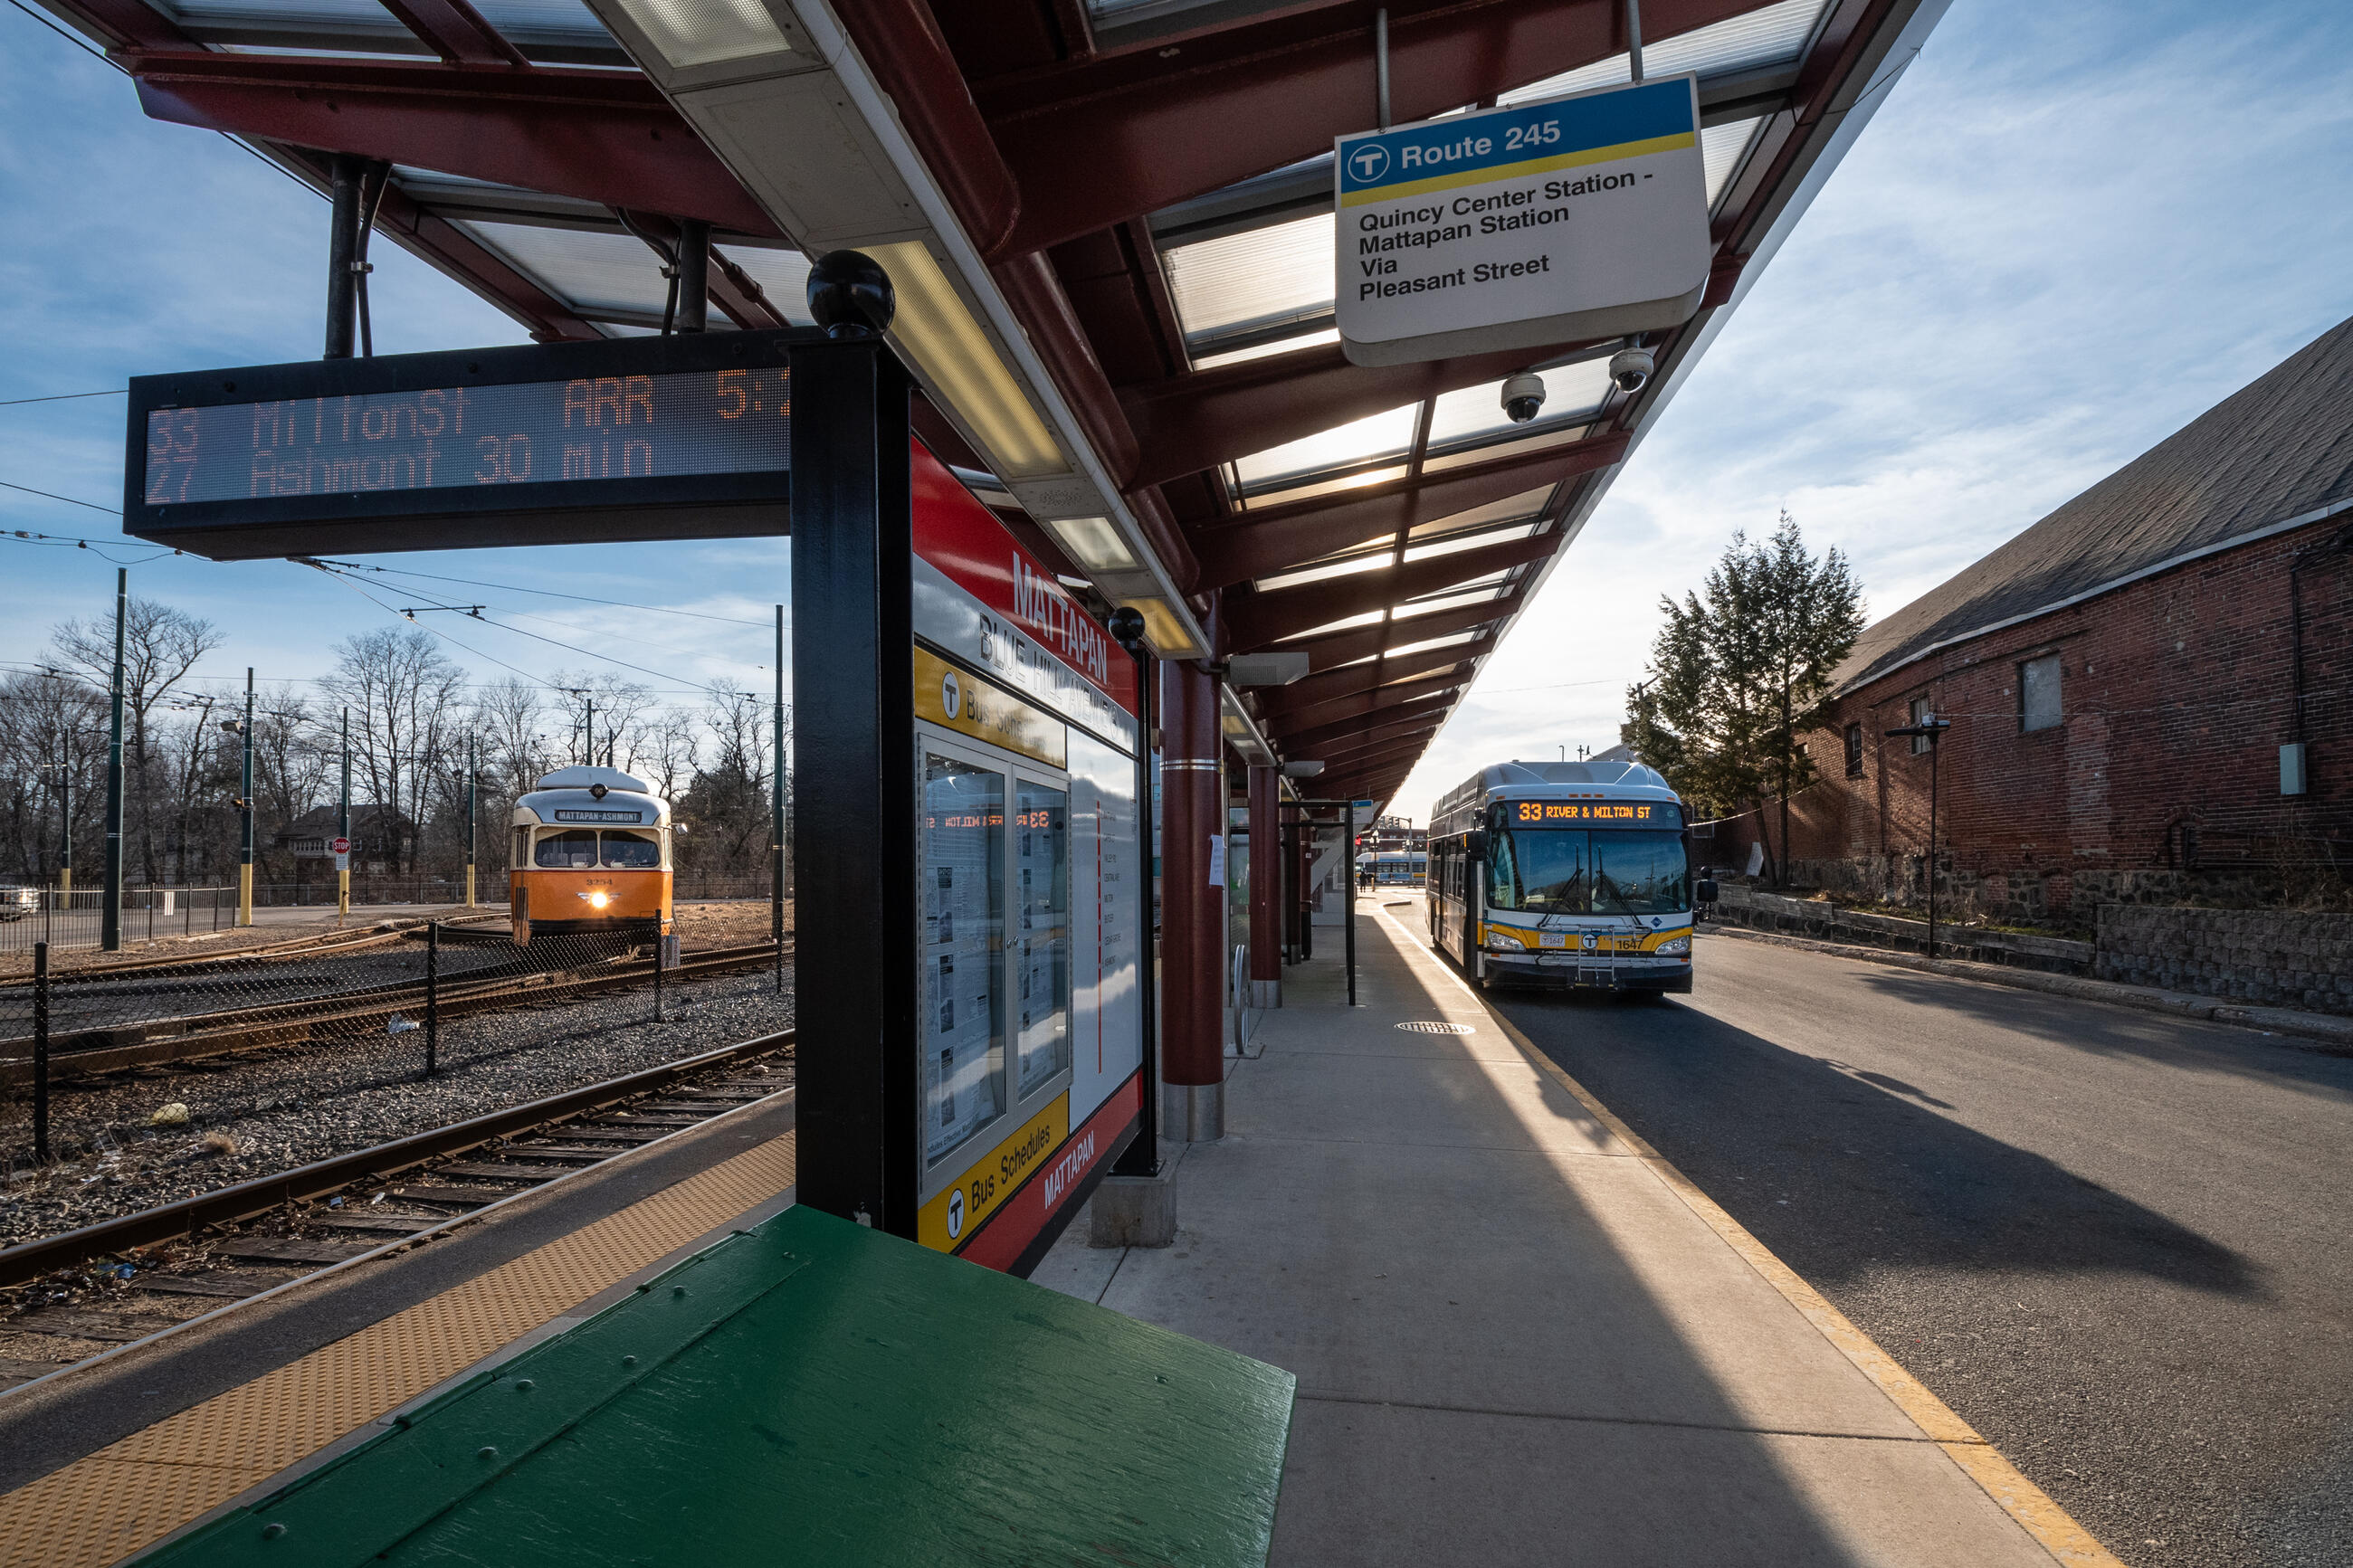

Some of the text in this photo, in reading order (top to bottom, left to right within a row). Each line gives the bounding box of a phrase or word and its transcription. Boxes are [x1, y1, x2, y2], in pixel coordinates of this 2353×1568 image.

[1401, 137, 1492, 169] Route
[1504, 119, 1561, 151] 245
[1359, 204, 1444, 233] Quincy
[1452, 186, 1537, 217] Center
[1543, 169, 1636, 201] Station
[1359, 205, 1570, 256] Mattapan Station
[1359, 254, 1550, 301] Pleasant Street
[1360, 256, 1398, 278] Via
[148, 406, 198, 455] 33
[564, 375, 653, 428] ARR
[145, 428, 653, 505] 27 Ashmont 30 min
[1013, 550, 1107, 686] MATTAPAN
[979, 613, 1025, 685] BLUE
[1034, 650, 1062, 704] HILL
[966, 689, 990, 727] Bus
[1519, 803, 1651, 822] 33 RIVER & MILTON ST
[334, 841, 349, 851] STOP
[1616, 939, 1644, 950] 1647
[971, 1174, 995, 1214] Bus
[1000, 1124, 1051, 1185] Schedules
[1043, 1129, 1095, 1210] MATTAPAN
